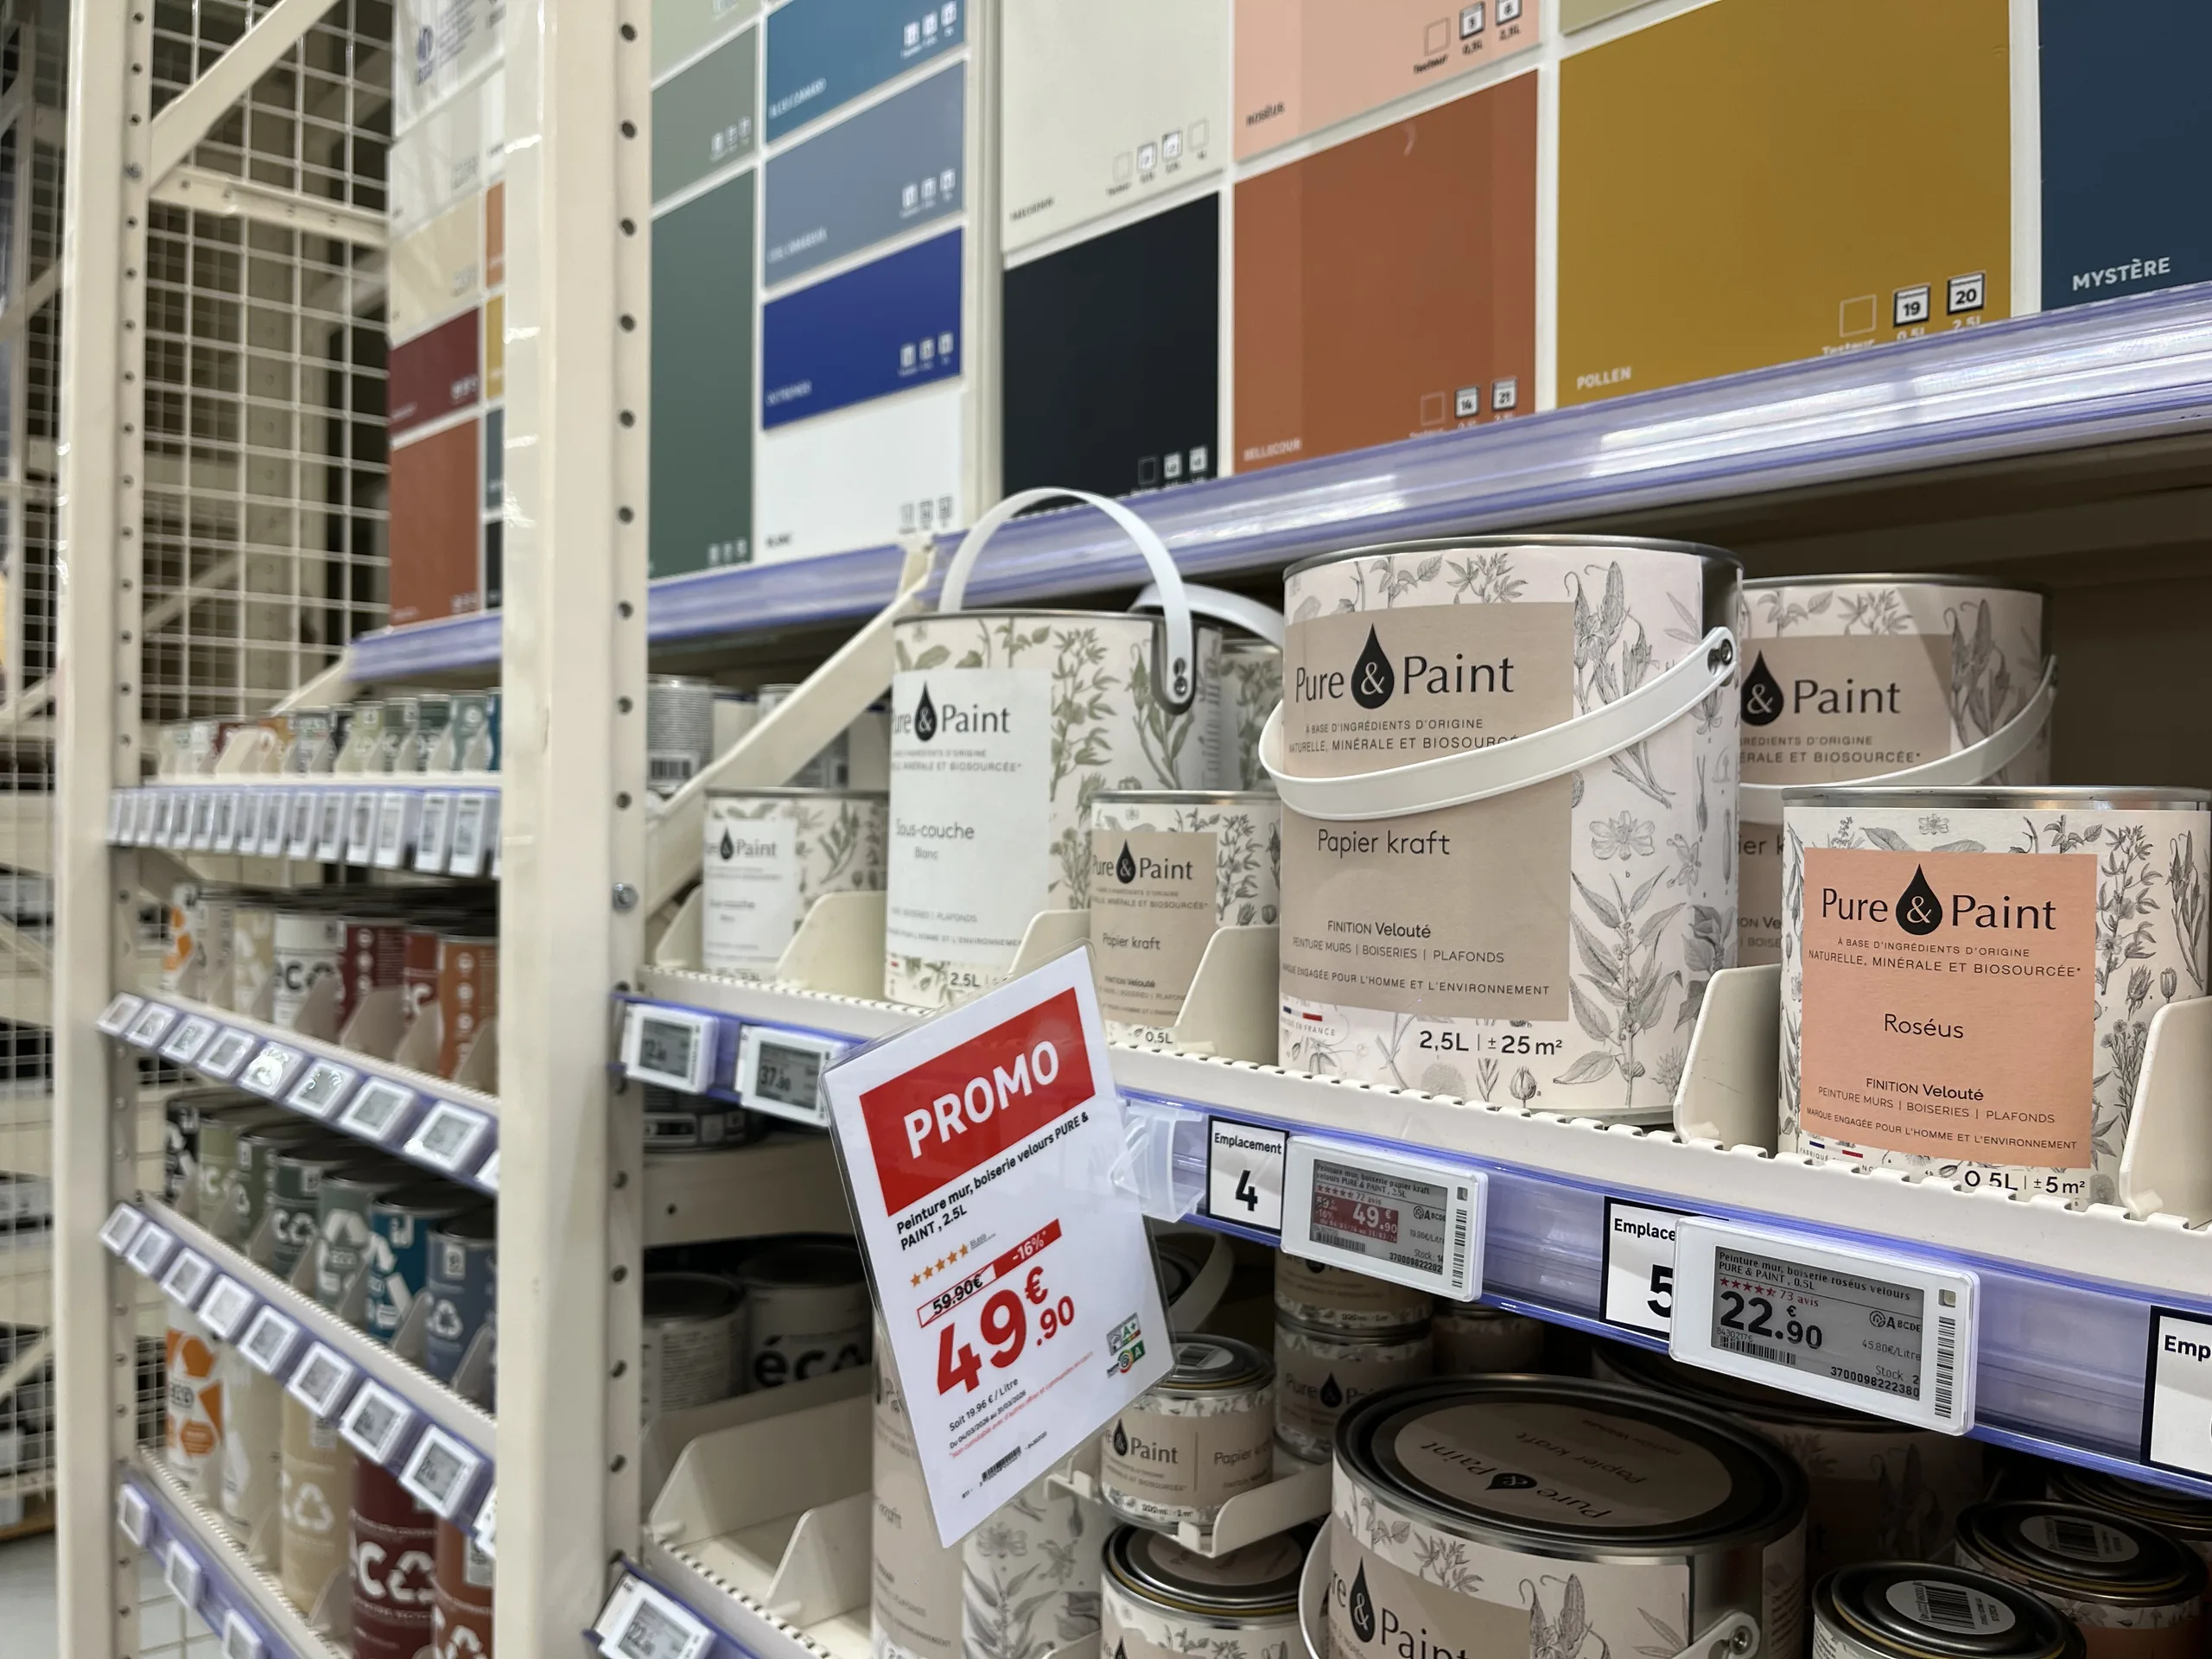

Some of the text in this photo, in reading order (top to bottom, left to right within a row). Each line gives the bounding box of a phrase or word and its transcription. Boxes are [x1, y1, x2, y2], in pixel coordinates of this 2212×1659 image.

[2073, 257, 2171, 291] MYSTÈRE
[1904, 289, 1978, 317] 19 20
[1577, 366, 1632, 389] POLLEN
[1295, 653, 1515, 702] Pure & Paint
[1746, 678, 1900, 715] & Paint
[918, 703, 1011, 734] & Paint
[1311, 718, 1484, 734] BASE D'INGRÉDIENTS D'ORIGINE
[1332, 737, 1394, 752] MINÉRALE
[1400, 737, 1416, 749] ET
[1807, 735, 1873, 747] D'ORIGINE
[1790, 752, 1808, 763] ET
[896, 817, 975, 840] Sous-couche
[735, 838, 778, 858] Paint
[914, 846, 938, 861] Blanc
[1318, 828, 1451, 856] Papier kraft
[1092, 855, 1193, 880] Pure & Paint
[1138, 899, 1147, 907] ET
[1821, 887, 2056, 931] Pure & Paint
[1103, 932, 1161, 951] Papier kraft
[1327, 920, 1432, 939] FINITION Velouté
[1325, 940, 1351, 954] MURS
[1362, 945, 1418, 960] BOISERIES
[1433, 950, 1504, 963] PLAFONDS
[1846, 938, 1869, 949] BASE
[1873, 941, 1960, 955] D'INGRÉDIENTS
[1966, 946, 2030, 958] D'ORIGINE
[1808, 949, 1867, 967] NATURELLE,
[1872, 955, 1942, 972] MINÉRALE
[1948, 963, 1967, 974] ET
[1127, 976, 1156, 988] Velouté
[1297, 966, 1549, 996] ENGAGÉE POUR L'HOMME ET L'ENVIRONNEMENT
[1304, 1024, 1336, 1036] FRANCE
[1885, 1013, 1964, 1039] Roséus
[1419, 1029, 1562, 1056] 2,5L 25 m²
[904, 1039, 1059, 1160] PROMO
[1866, 1077, 1985, 1102] FINITION Velouté
[1818, 1085, 2056, 1124] PEINTURE MURS BOISERIES PLAFONDS
[1806, 1107, 2077, 1150] MARQUE ENGAGÉE POUR L'HOMME ET L'ENVIRONNEMENT
[1214, 1132, 1282, 1155] Emplacement
[896, 1111, 1090, 1235] Peinture mur, boiserie velours PURE &
[1316, 1163, 1343, 1176] Peinture
[1361, 1173, 1388, 1185] boiserie
[1389, 1180, 1411, 1192] papier
[1413, 1185, 1430, 1195] kraft
[1316, 1172, 1340, 1184] velours
[1341, 1176, 1357, 1187] PURE
[1366, 1183, 1386, 1194] PAINT
[2045, 1176, 2085, 1194] 5 m²
[1235, 1168, 1258, 1212] 4
[1356, 1192, 1382, 1205] 72 avis
[900, 1204, 968, 1251] PAINT 2.5L
[1352, 1202, 1379, 1228] 49
[1385, 1209, 1392, 1219] €
[1614, 1217, 1675, 1241] Emplace
[1719, 1251, 1910, 1301] Peinture mur, boiserie roséus velours
[1719, 1262, 1815, 1290] PURE & PAINT 0.5L
[932, 1274, 983, 1316] 59.90€
[1647, 1264, 1674, 1318] 5
[1780, 1290, 1819, 1307] 73 avis
[1786, 1305, 1797, 1318] €
[937, 1266, 1075, 1396] 49 € .90
[1830, 1365, 1920, 1397] 3700098222380
[1912, 1374, 1919, 1385] 2
[949, 1378, 1019, 1432] Soit 19.96 € Litre
[949, 1439, 958, 1450] Du
[990, 1412, 998, 1421] au
[1130, 1437, 1179, 1465] Paint
[1214, 1448, 1252, 1467] Papier
[1421, 1440, 1499, 1478] Paint
[1516, 1431, 1648, 1485] Papier kraft
[1537, 1487, 1613, 1520] Pure
[1354, 1592, 1370, 1631] &
